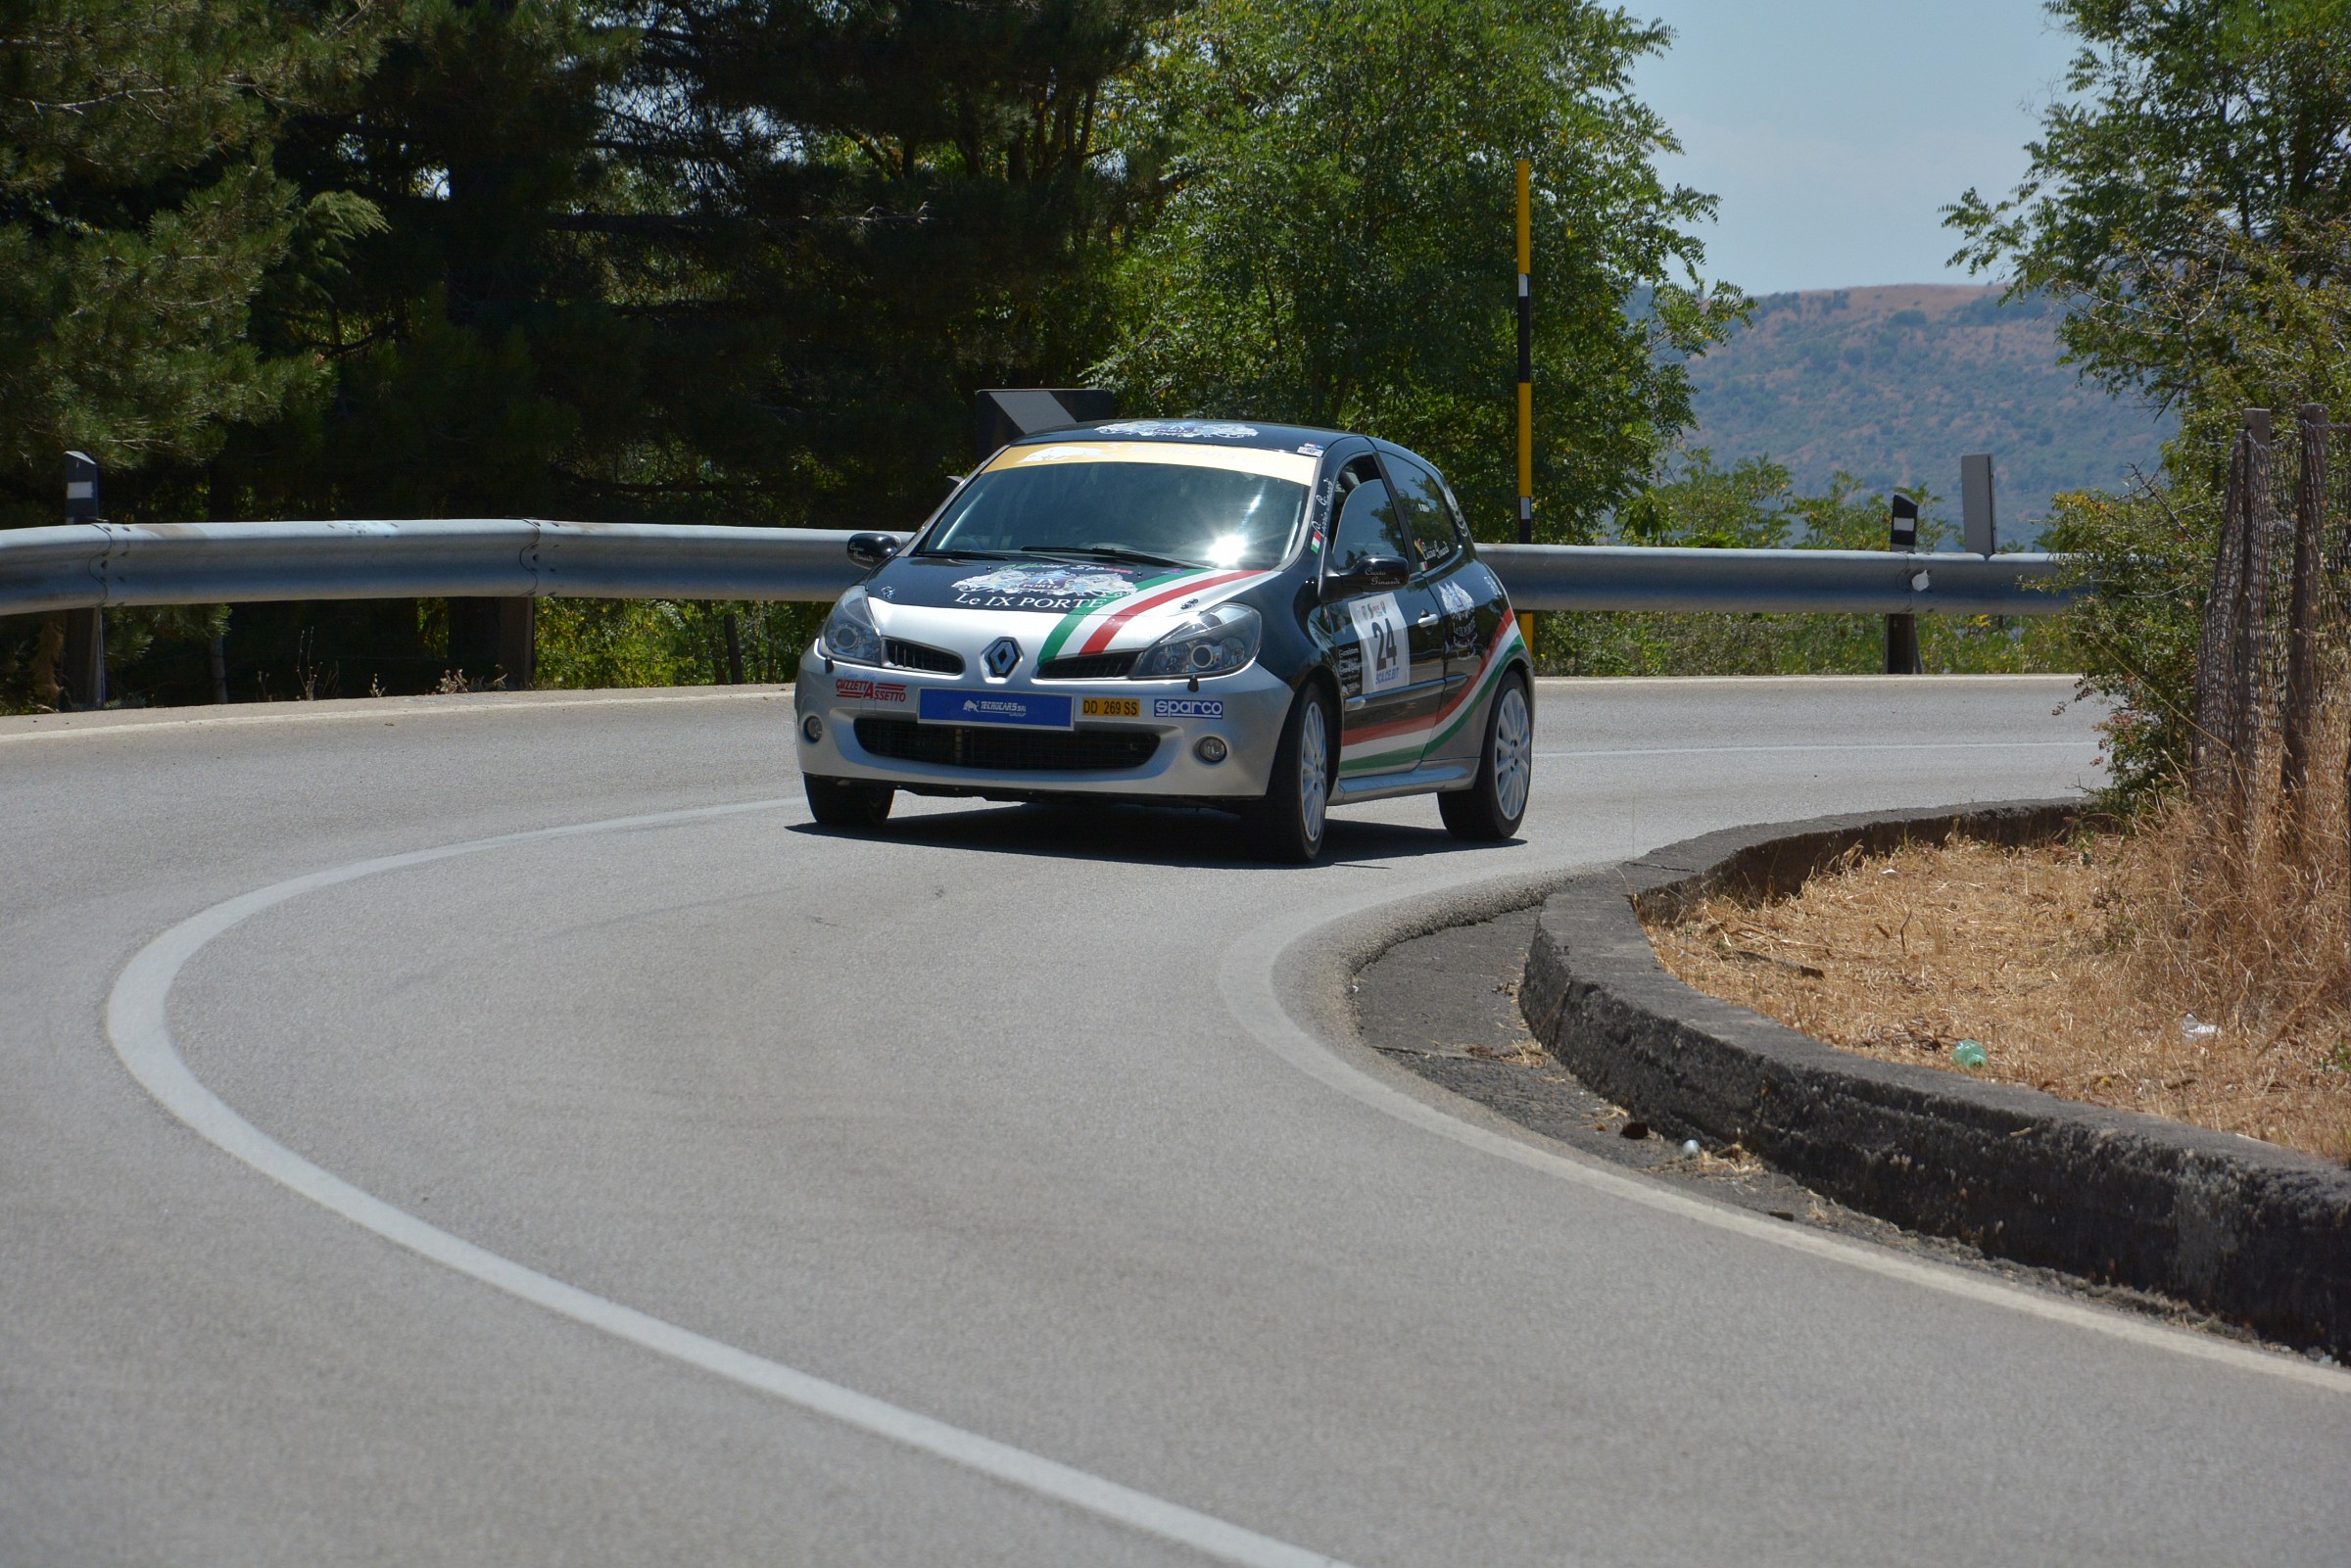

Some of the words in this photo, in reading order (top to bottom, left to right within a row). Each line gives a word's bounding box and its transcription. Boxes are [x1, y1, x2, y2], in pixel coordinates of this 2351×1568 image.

[955, 593, 980, 606] Le
[984, 596, 1015, 606] IX
[1019, 596, 1107, 608] PORTE
[1371, 618, 1398, 671] 24
[1082, 700, 1097, 714] DD
[1103, 700, 1122, 715] 269
[1124, 701, 1137, 716] SS
[1155, 700, 1223, 717] sparco
